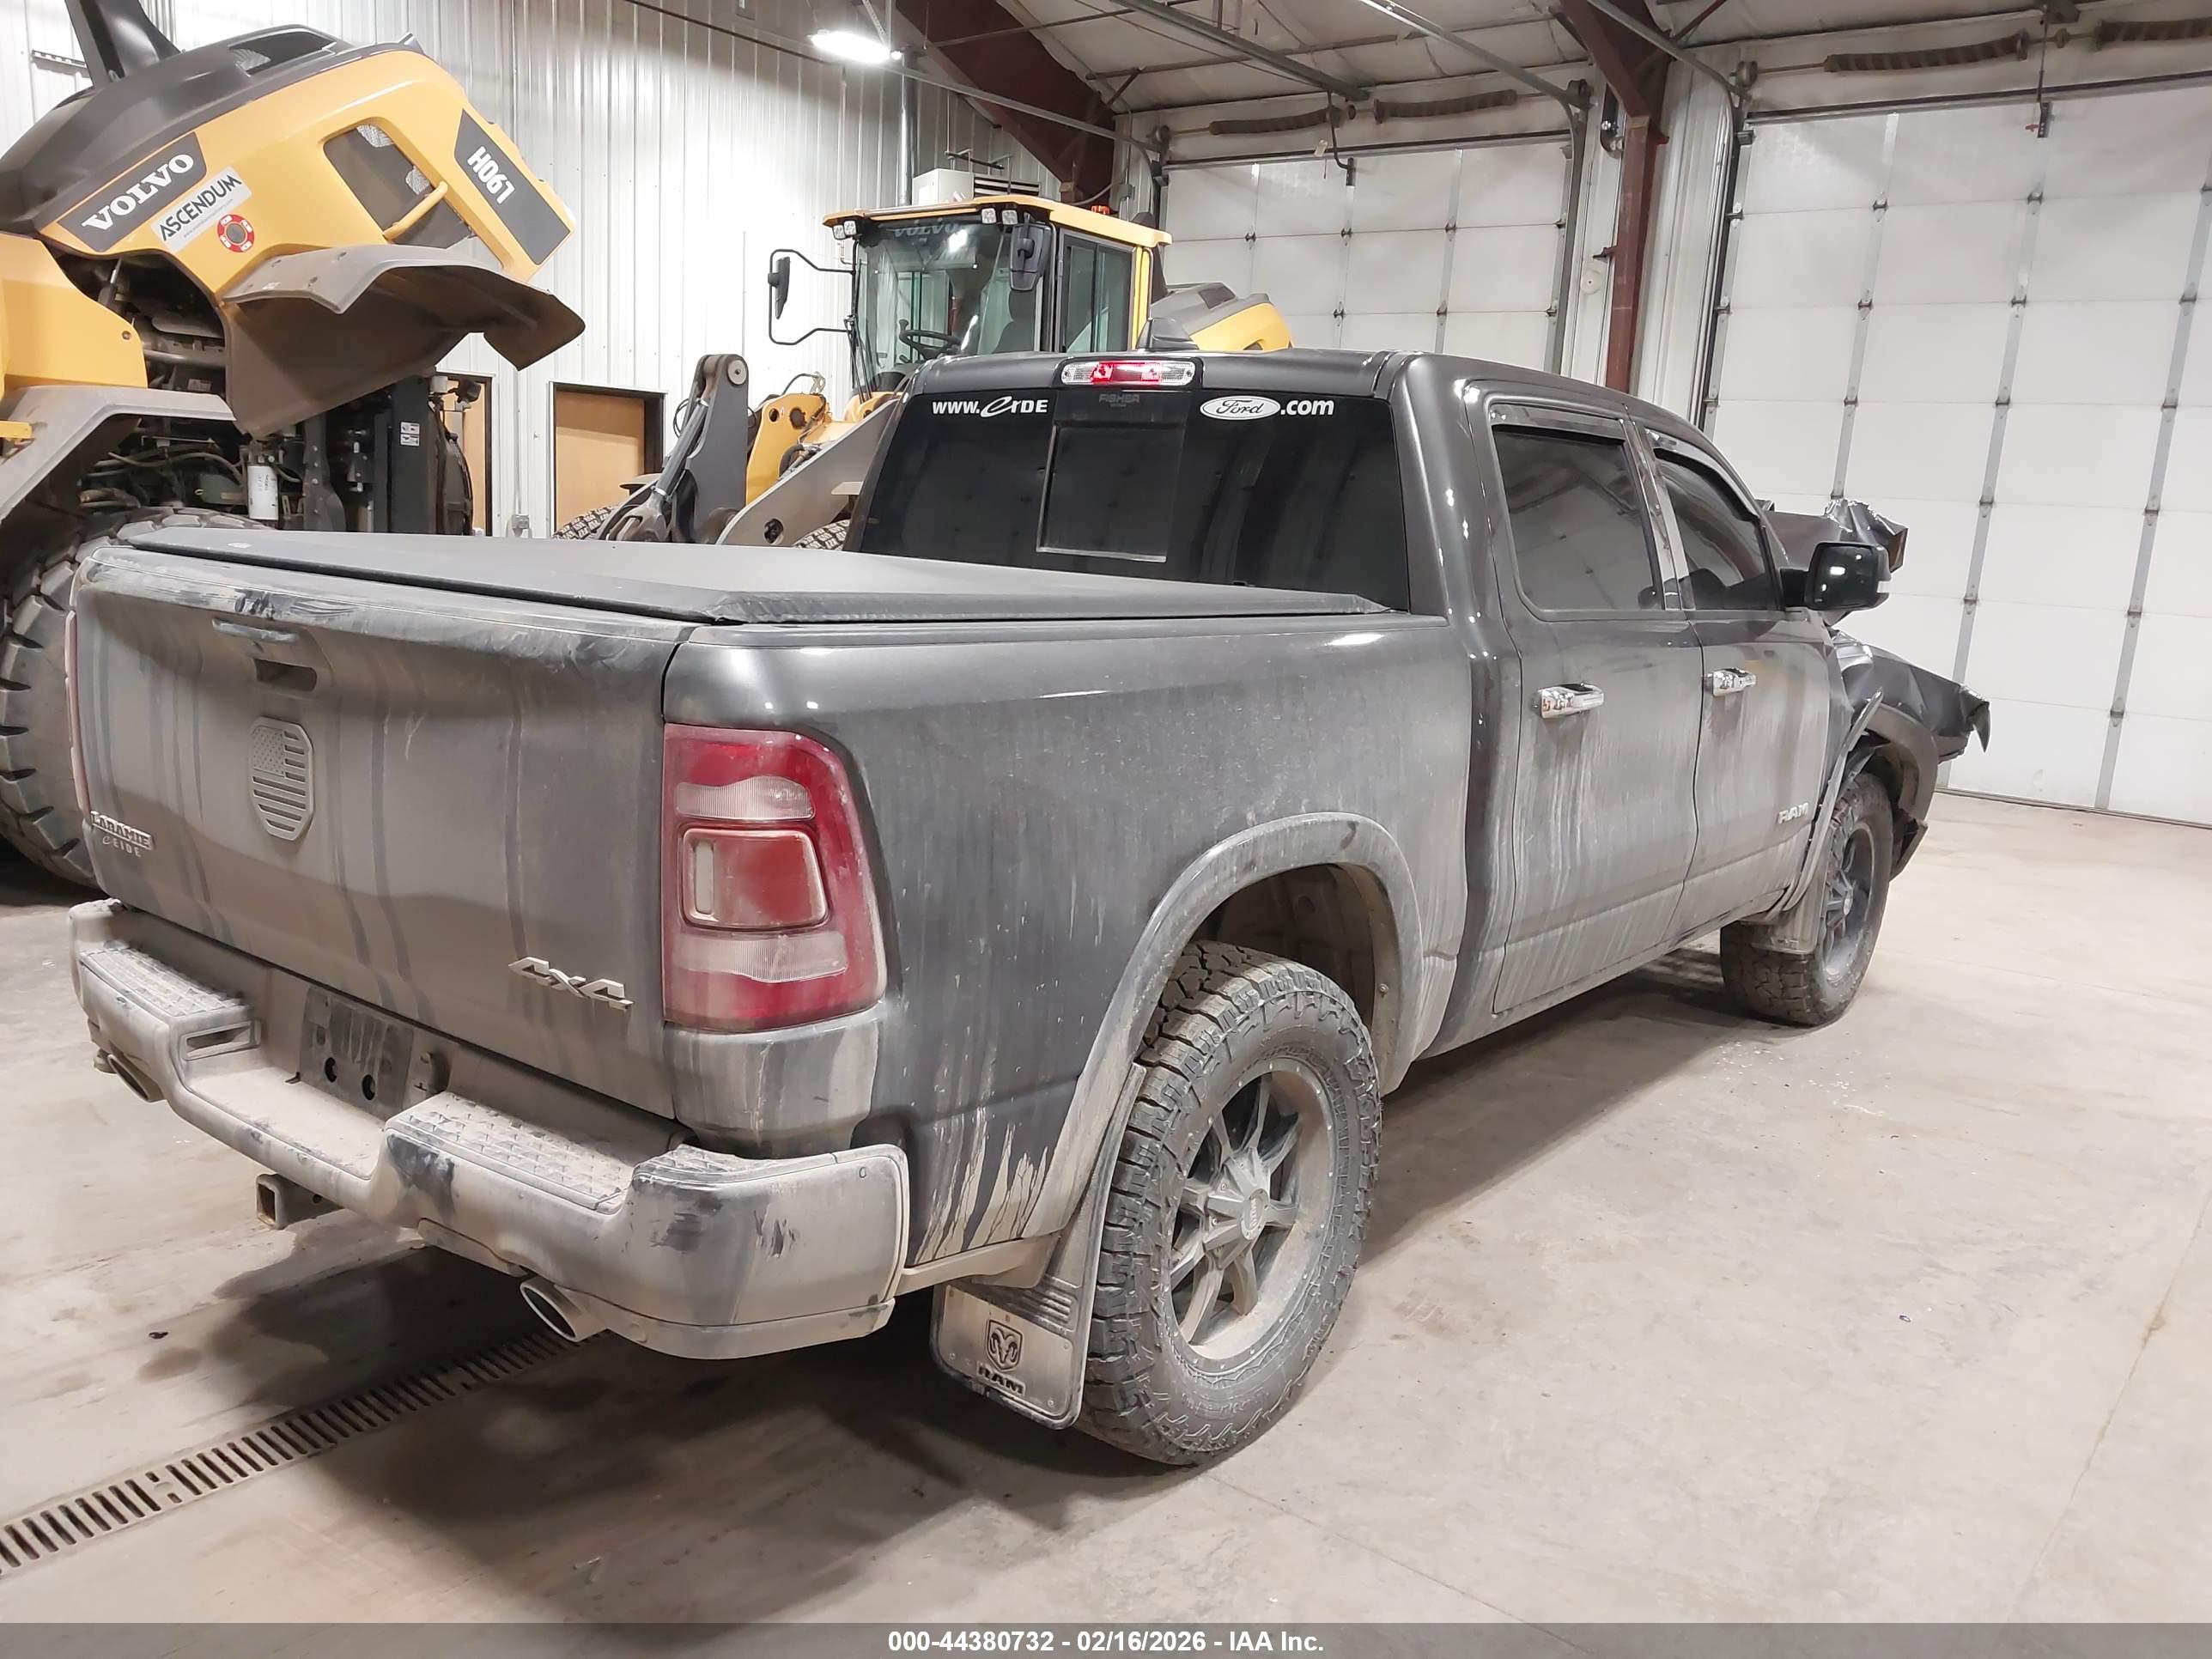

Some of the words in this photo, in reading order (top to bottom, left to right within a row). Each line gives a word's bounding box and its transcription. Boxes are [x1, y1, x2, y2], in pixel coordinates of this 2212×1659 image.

[82, 154, 194, 231] VOLVO
[158, 174, 242, 241] ASCENDUM
[1778, 802, 1808, 824] RAM
[977, 1362, 1025, 1395] RAM
